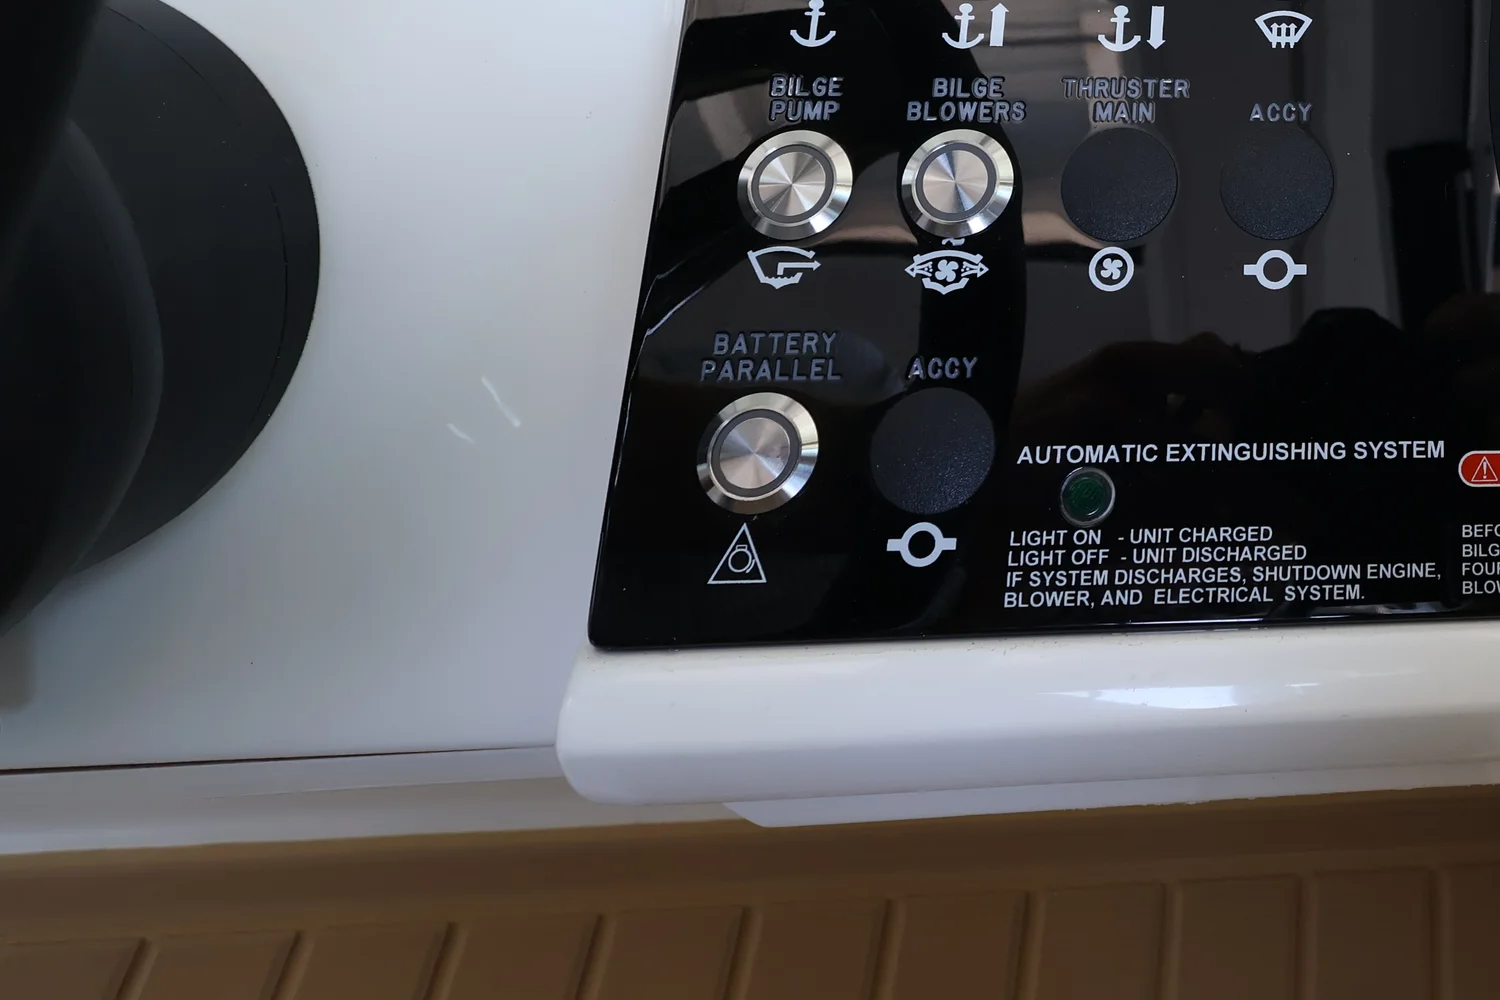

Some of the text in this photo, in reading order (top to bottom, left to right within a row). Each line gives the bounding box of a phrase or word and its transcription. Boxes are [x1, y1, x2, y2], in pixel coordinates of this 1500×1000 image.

[770, 75, 843, 97] BILGE
[932, 76, 1005, 98] BILGE
[1063, 77, 1191, 99] THRUSTER
[769, 101, 840, 122] PUMP
[907, 101, 1027, 122] BLOWERS
[1094, 102, 1156, 123] MAIN
[1250, 103, 1312, 122] ACCY
[713, 331, 837, 355] BATTERY
[700, 358, 842, 382] PARALLEL
[908, 356, 978, 379] ACCY
[1016, 440, 1445, 465] AUTOMATIC EXTINGUISHING SYSTEM
[1009, 525, 1273, 547] LIGHT ON UNIT CHARGED
[1007, 544, 1307, 567] LIGHT OFF UNIT DISCHARGED
[1006, 562, 1441, 588] IF SYSTEM DISCHARGES, SHUTDOWN ENGINE,
[1003, 583, 1365, 609] BLOWER, AND ELECTRICAL SYSTEM.
